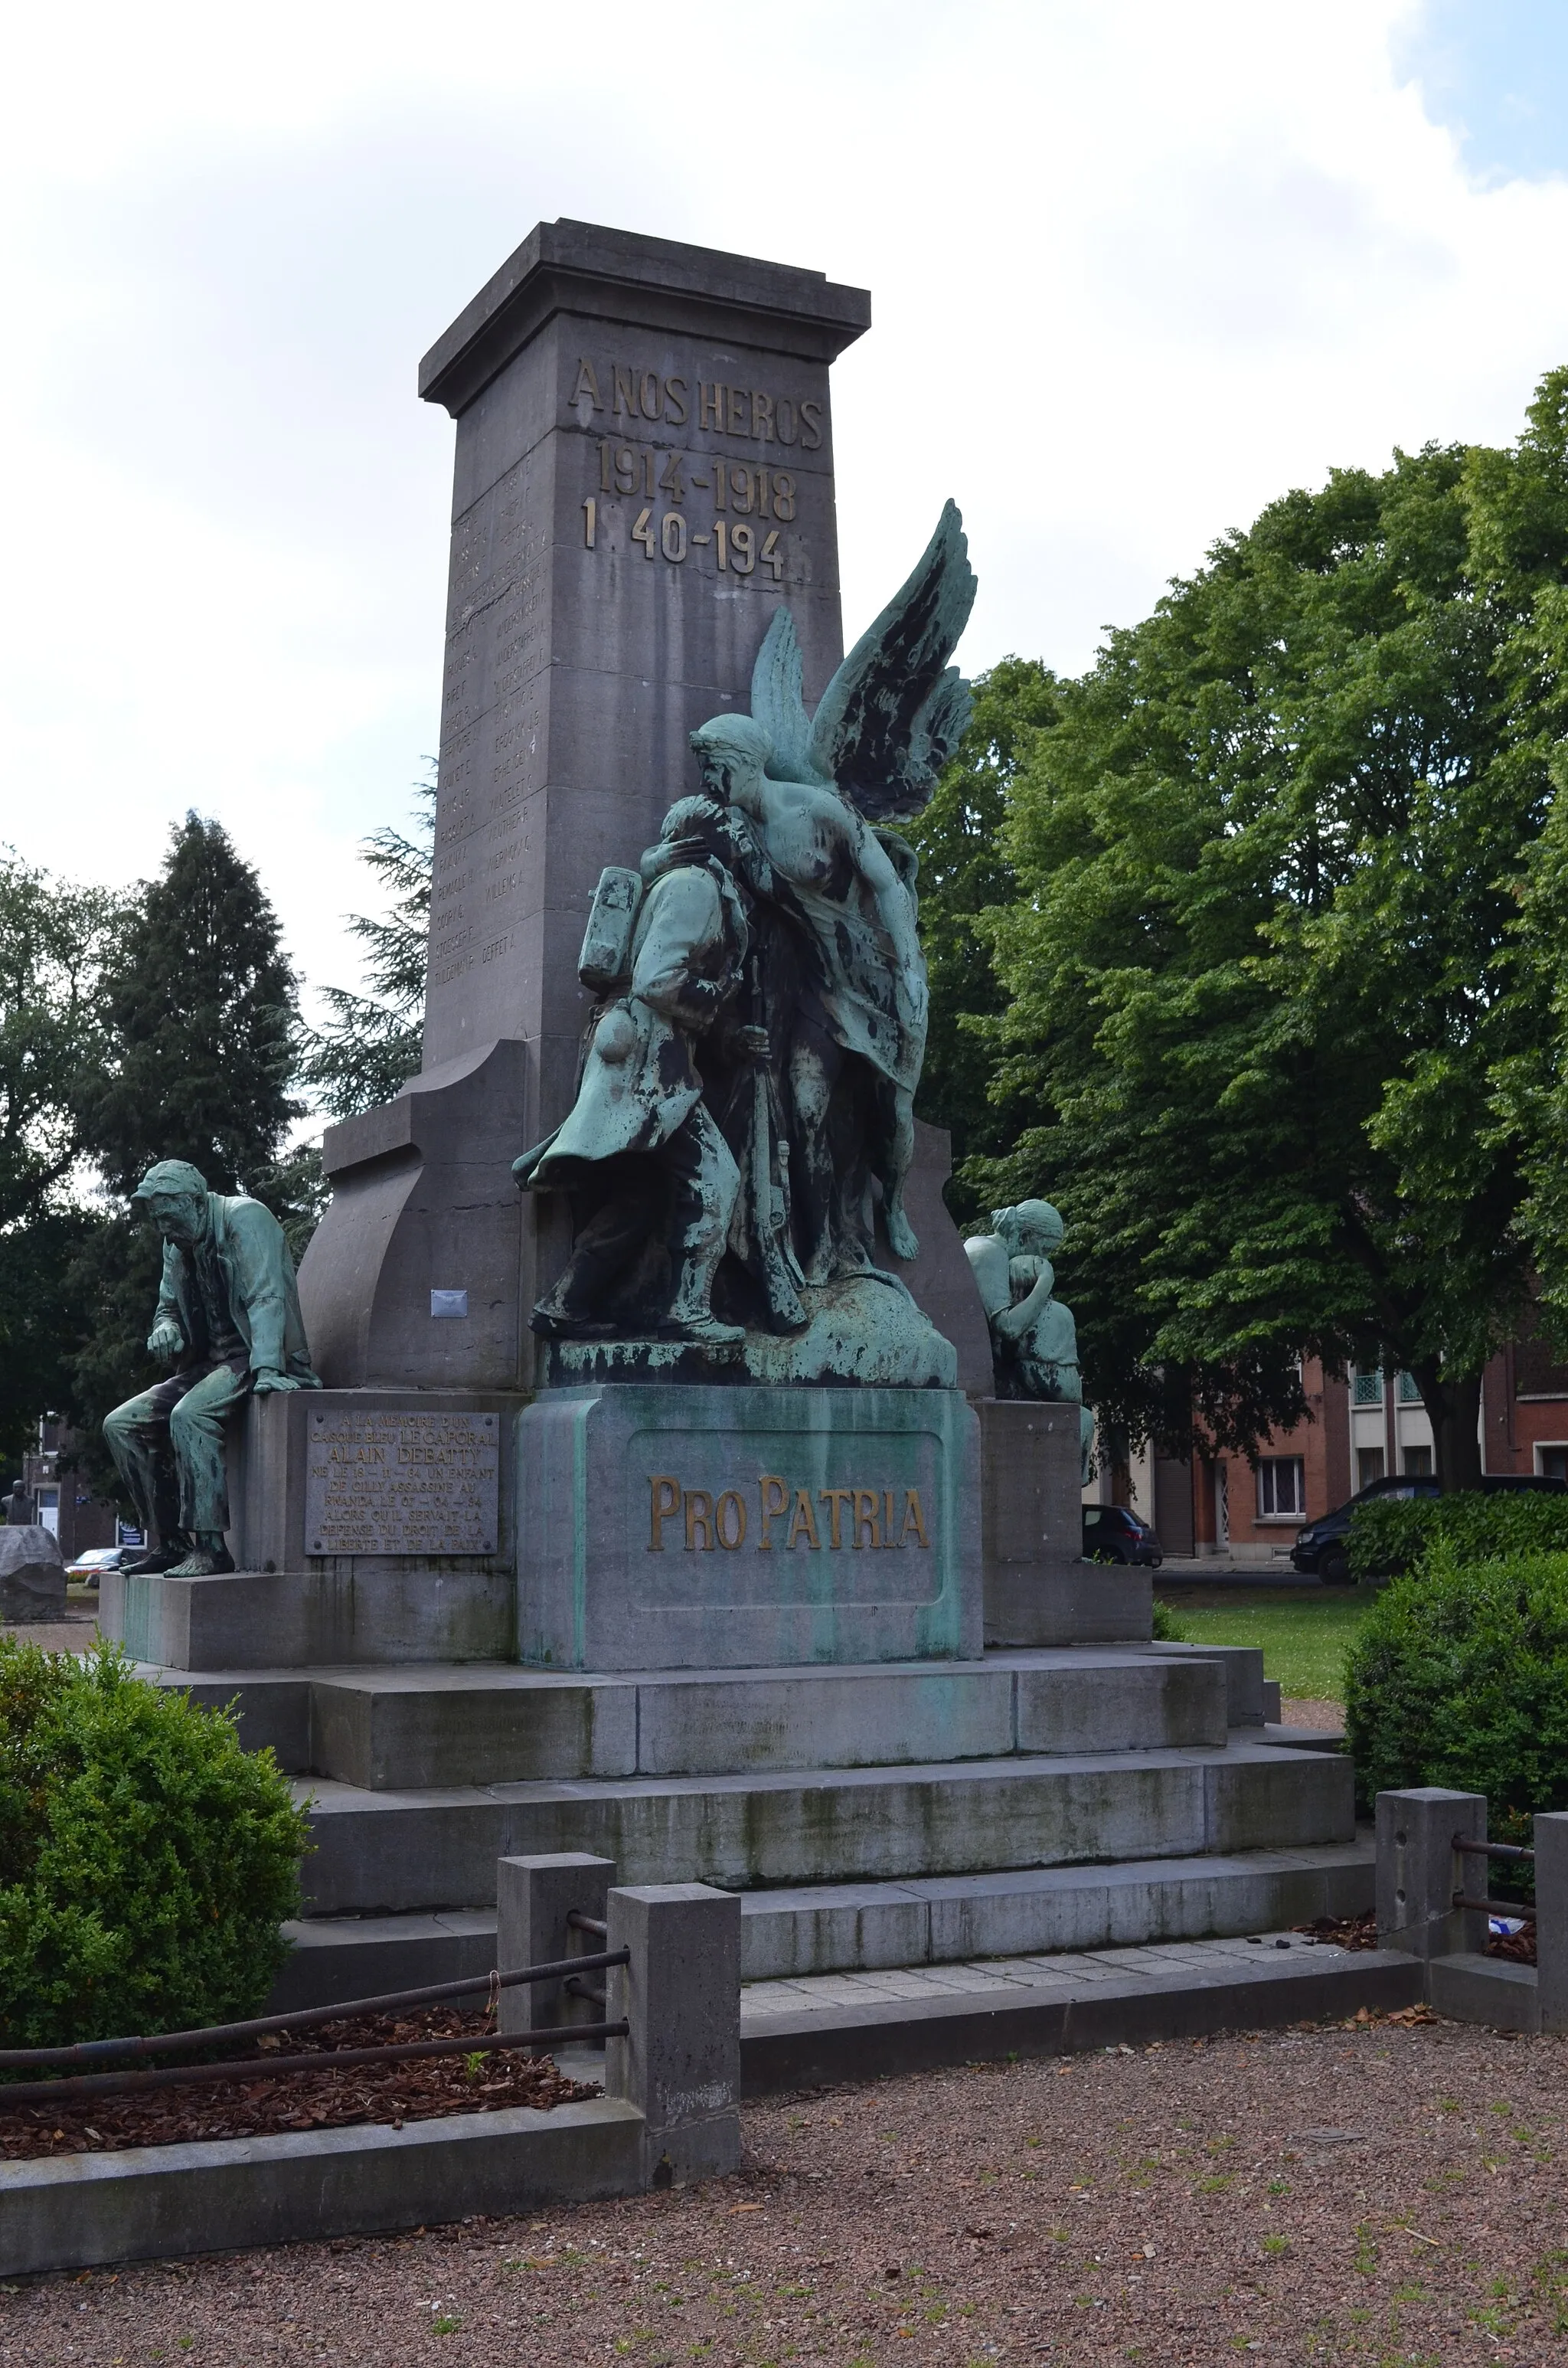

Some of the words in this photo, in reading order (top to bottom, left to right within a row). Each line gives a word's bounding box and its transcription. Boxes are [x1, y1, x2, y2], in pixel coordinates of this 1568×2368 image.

[568, 358, 604, 411] A
[612, 364, 689, 426] NOS
[697, 381, 823, 450] HEROS
[596, 439, 796, 522] 1914-1918
[355, 1415, 373, 1427] LA
[311, 1432, 363, 1444] CASQUE
[400, 1430, 421, 1445] LE
[423, 1431, 498, 1447] CAPORAL
[328, 1445, 386, 1464] ALAIN
[397, 1447, 482, 1465] DEBATTY
[329, 1480, 347, 1492] DE
[646, 1474, 748, 1552] PRO
[758, 1474, 931, 1550] PATRIA
